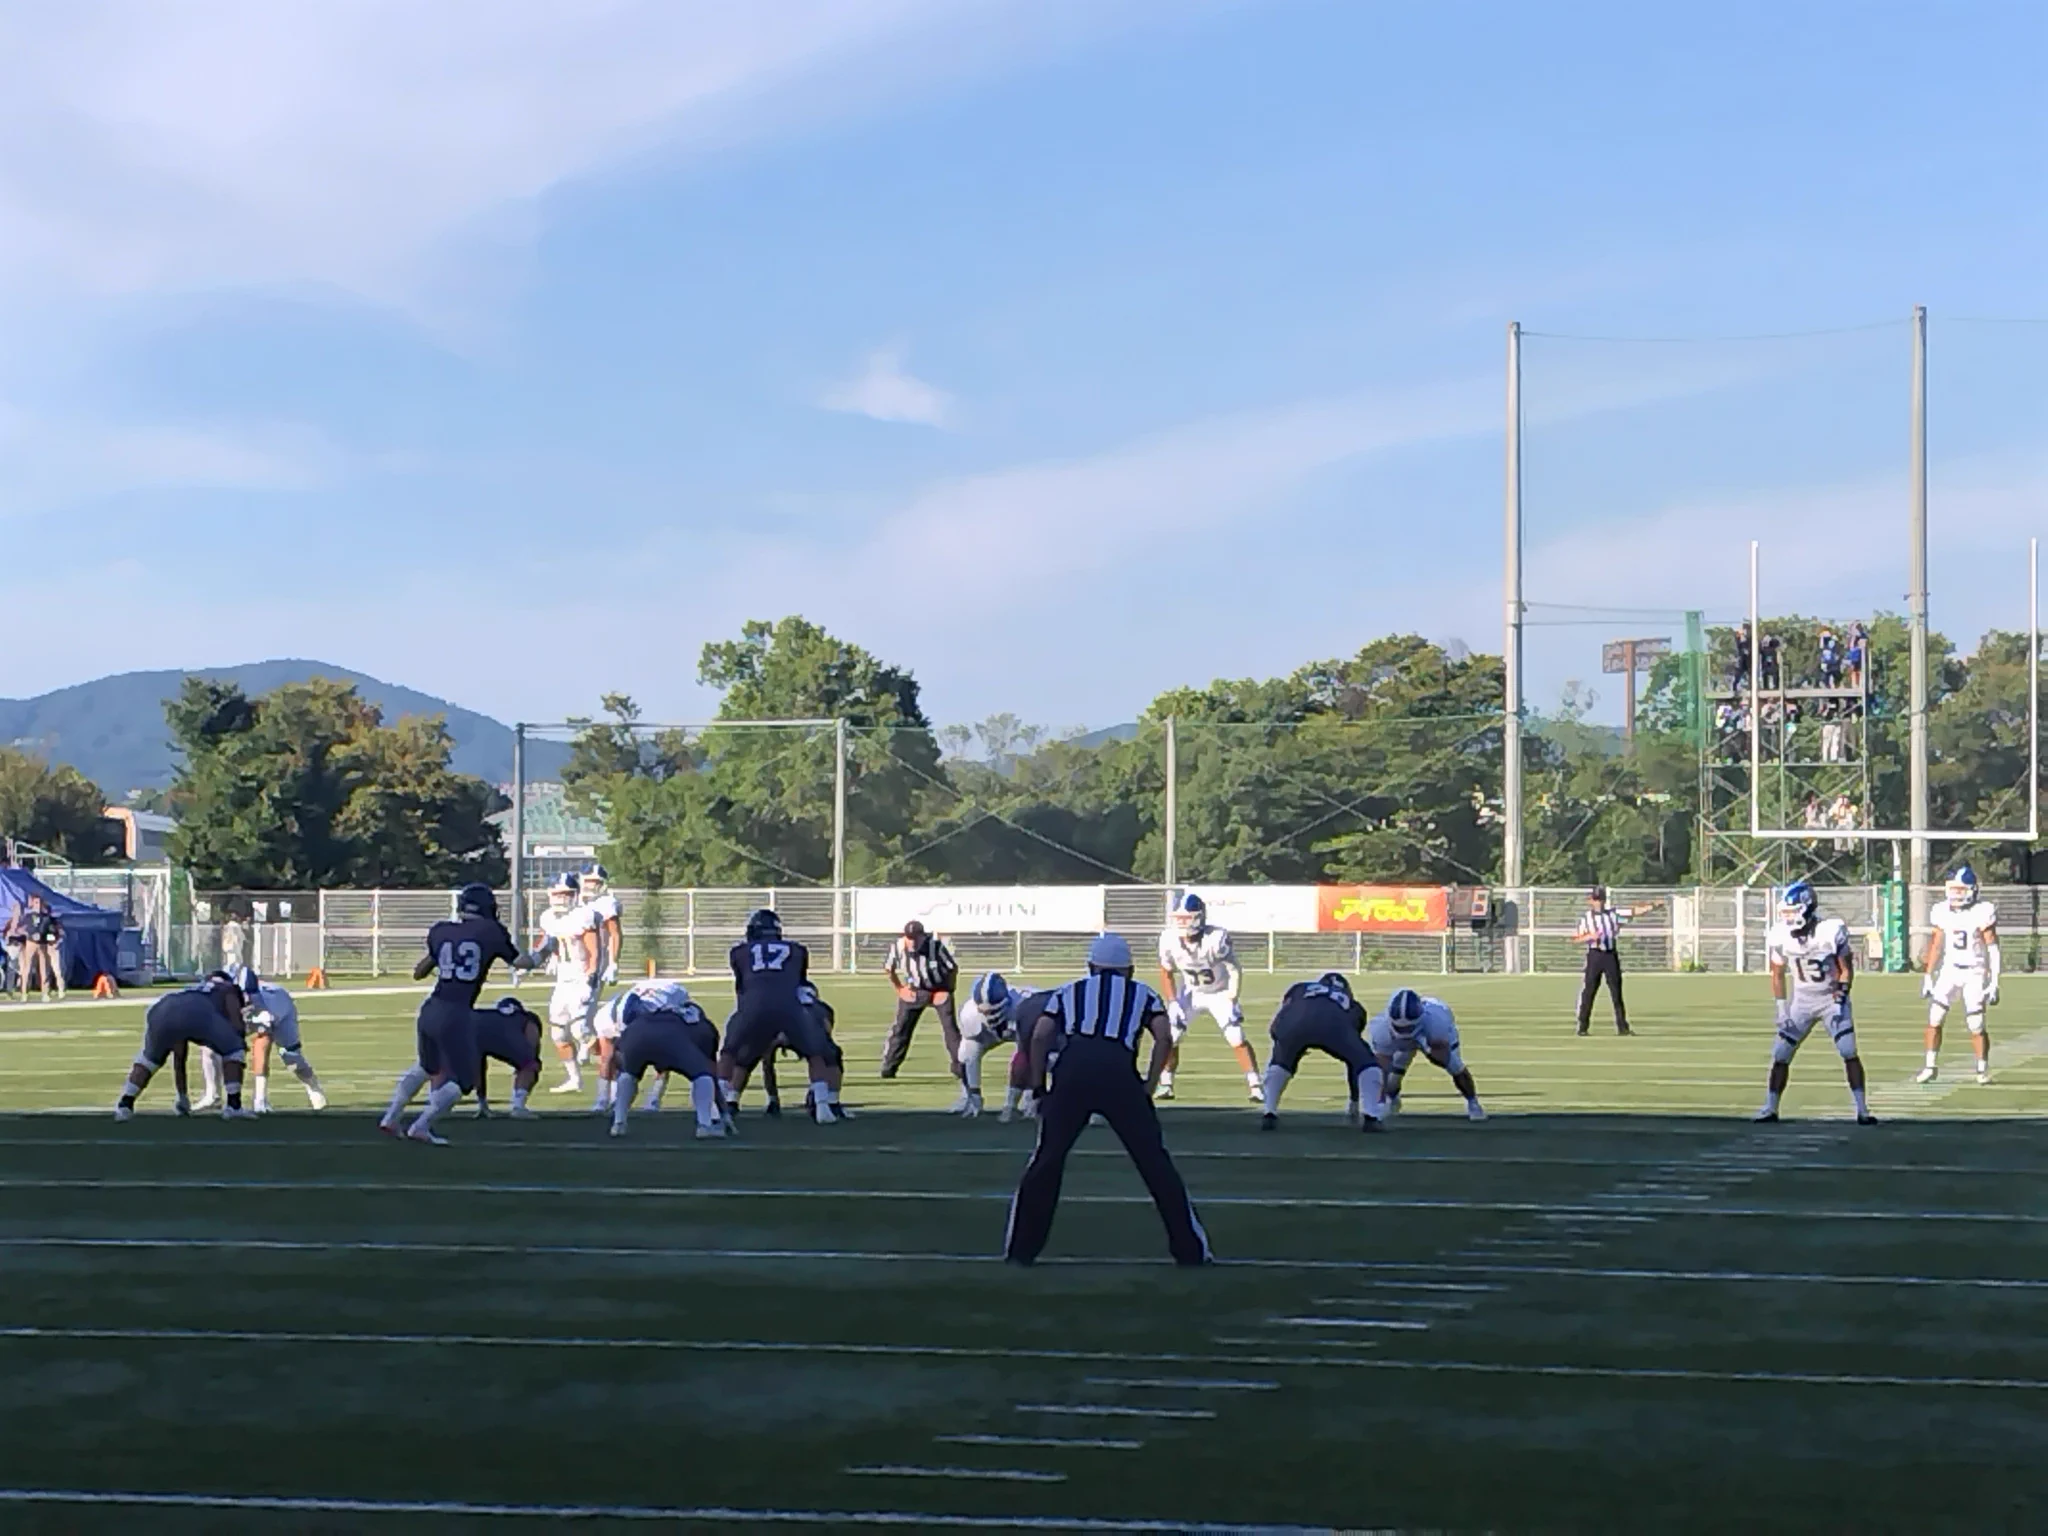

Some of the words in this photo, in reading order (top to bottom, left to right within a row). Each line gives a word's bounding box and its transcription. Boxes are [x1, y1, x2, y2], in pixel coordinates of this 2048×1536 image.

[1952, 930, 1968, 950] 3
[438, 941, 481, 980] 43
[750, 943, 790, 971] 17
[1795, 957, 1826, 982] 13
